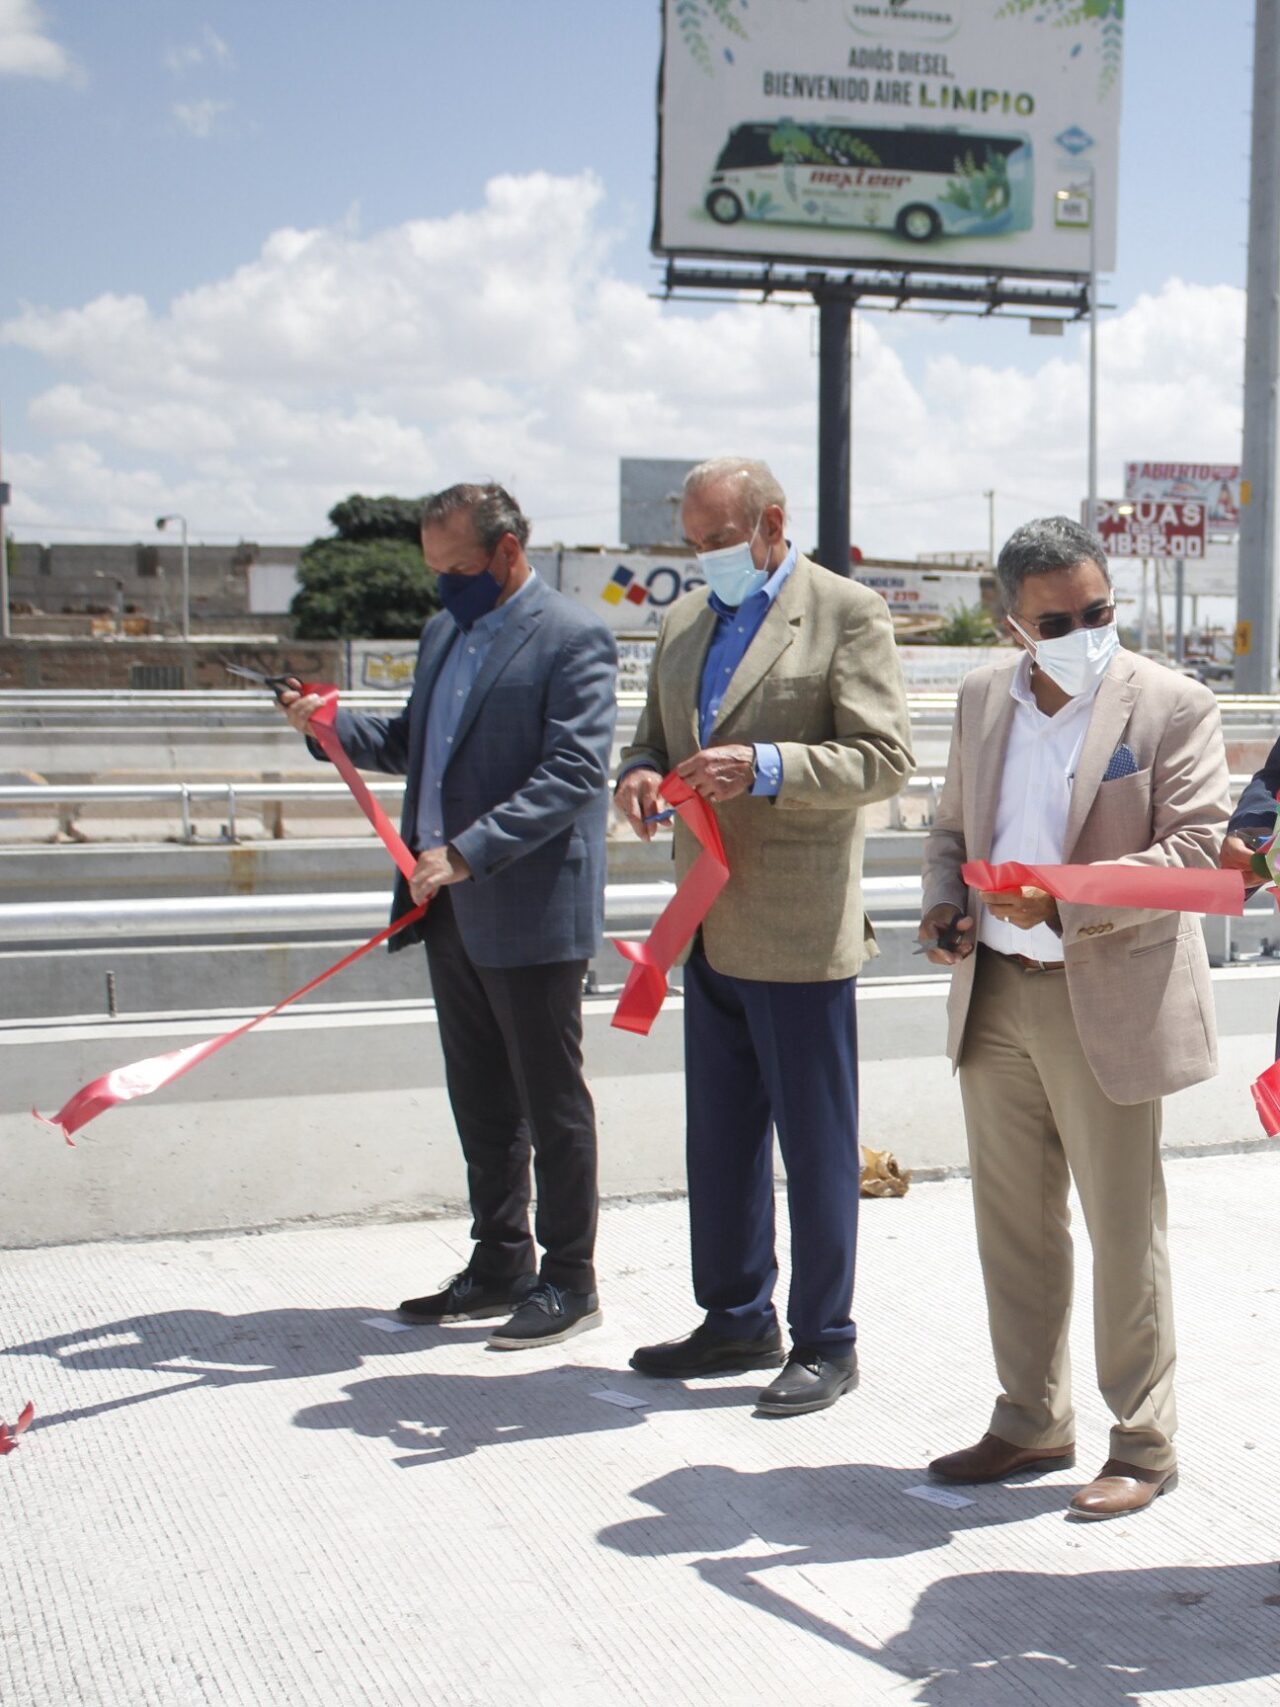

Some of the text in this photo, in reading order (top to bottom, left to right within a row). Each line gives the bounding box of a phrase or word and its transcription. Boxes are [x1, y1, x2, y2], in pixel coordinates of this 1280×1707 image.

[848, 45, 955, 79] ADIÓS DIESEL,
[763, 71, 1035, 117] BIENVENIDO AIRE LIMPIO
[1140, 463, 1210, 480] ABIERTO
